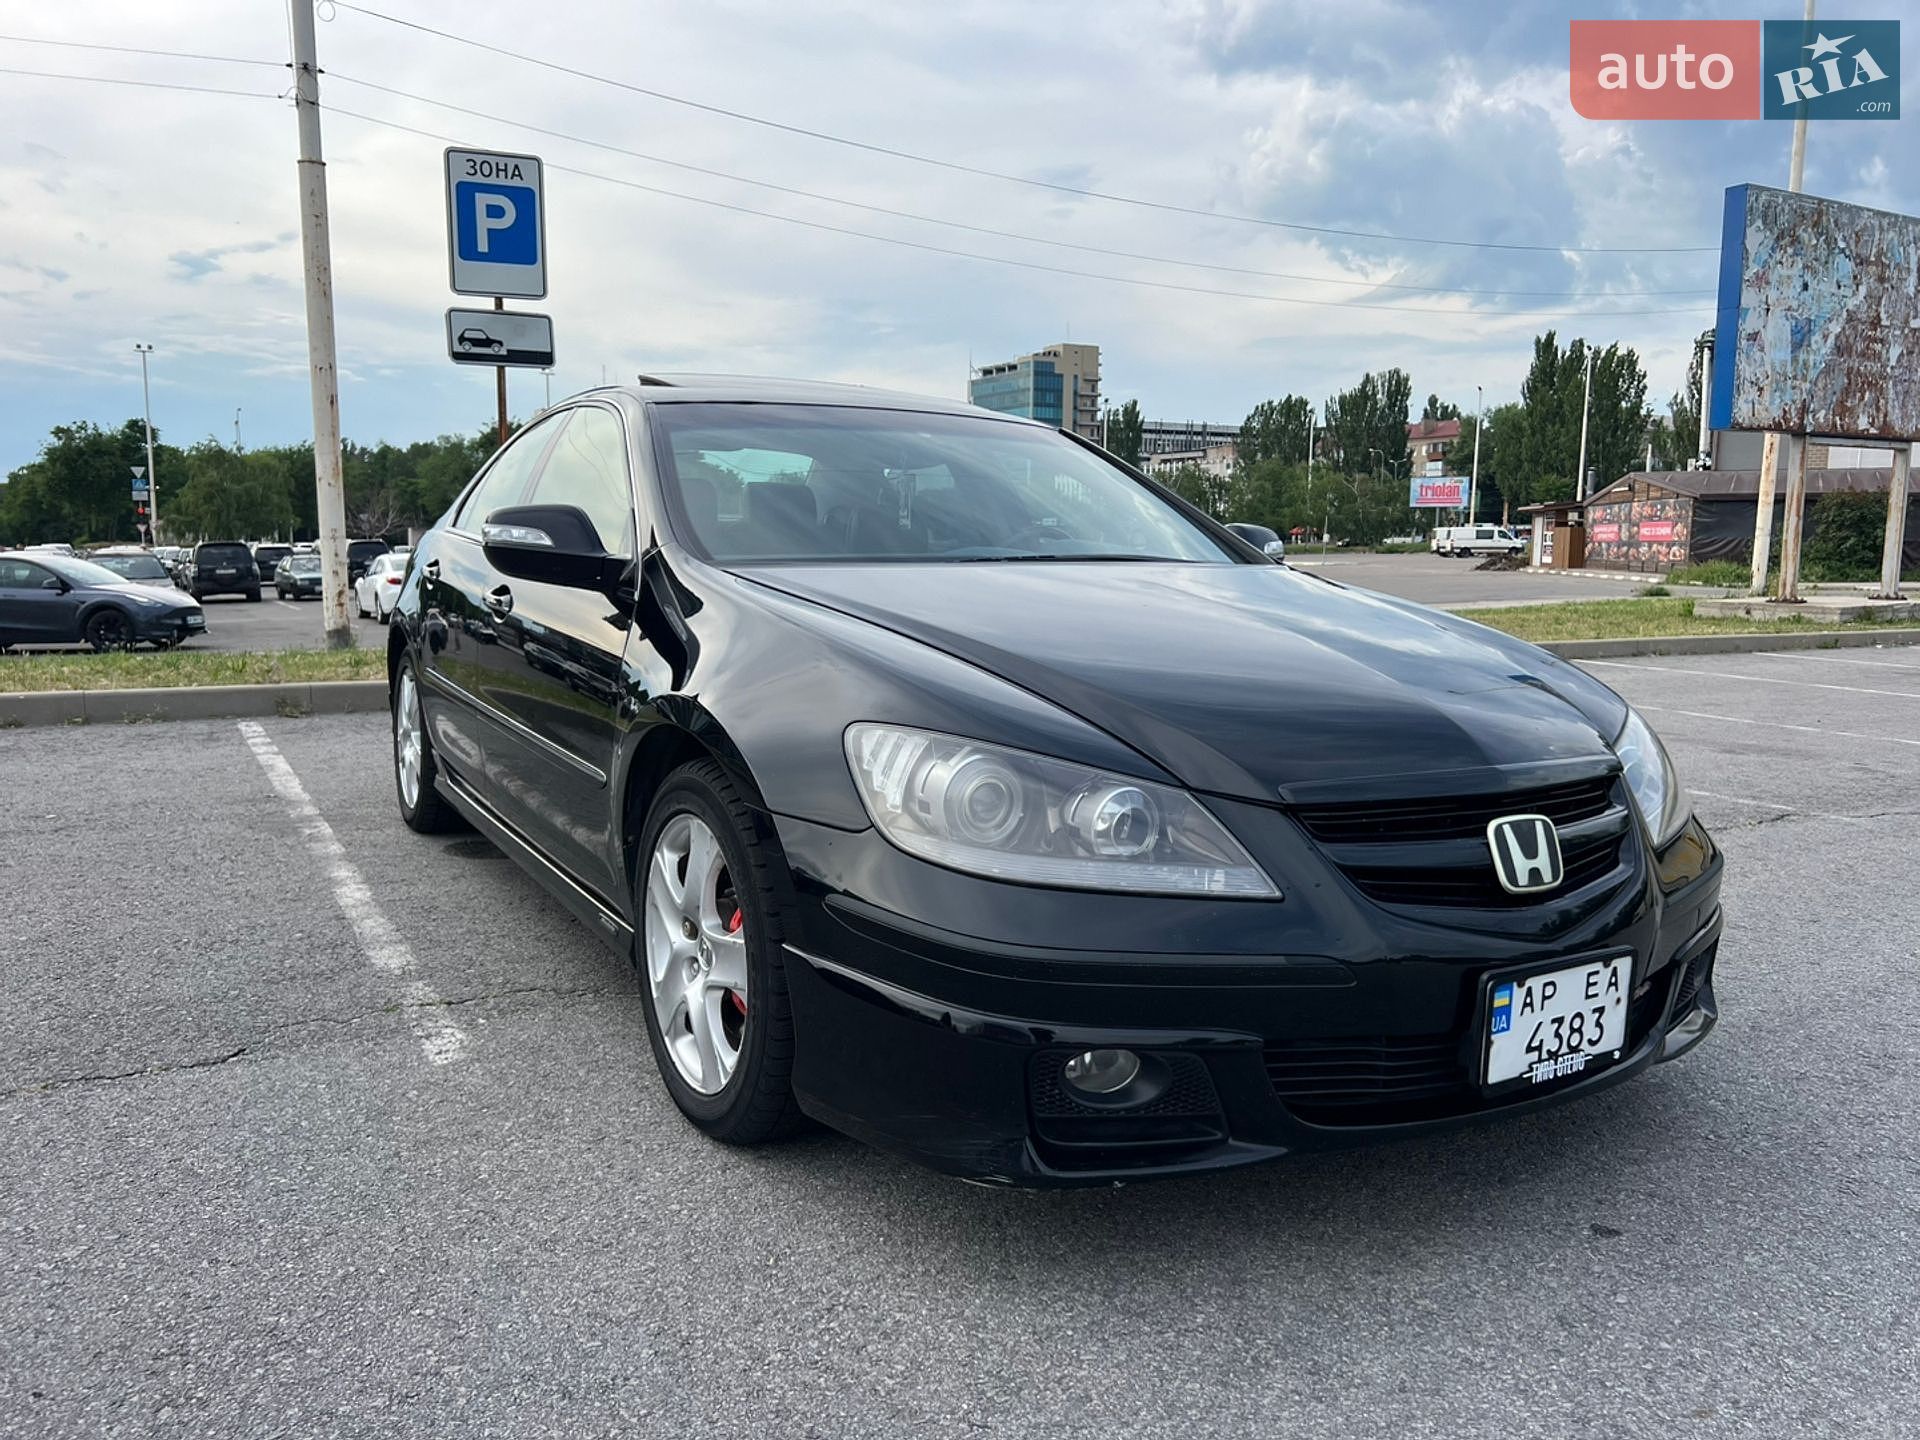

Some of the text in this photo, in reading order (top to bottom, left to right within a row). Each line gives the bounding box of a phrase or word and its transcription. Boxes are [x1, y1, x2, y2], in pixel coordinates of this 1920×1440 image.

[465, 158, 524, 181] ЗОНА
[474, 192, 517, 253] P
[1419, 482, 1461, 497] triolan
[1520, 966, 1619, 1016] AP EA
[1491, 1015, 1507, 1032] UA
[1525, 1005, 1606, 1061] 4383
